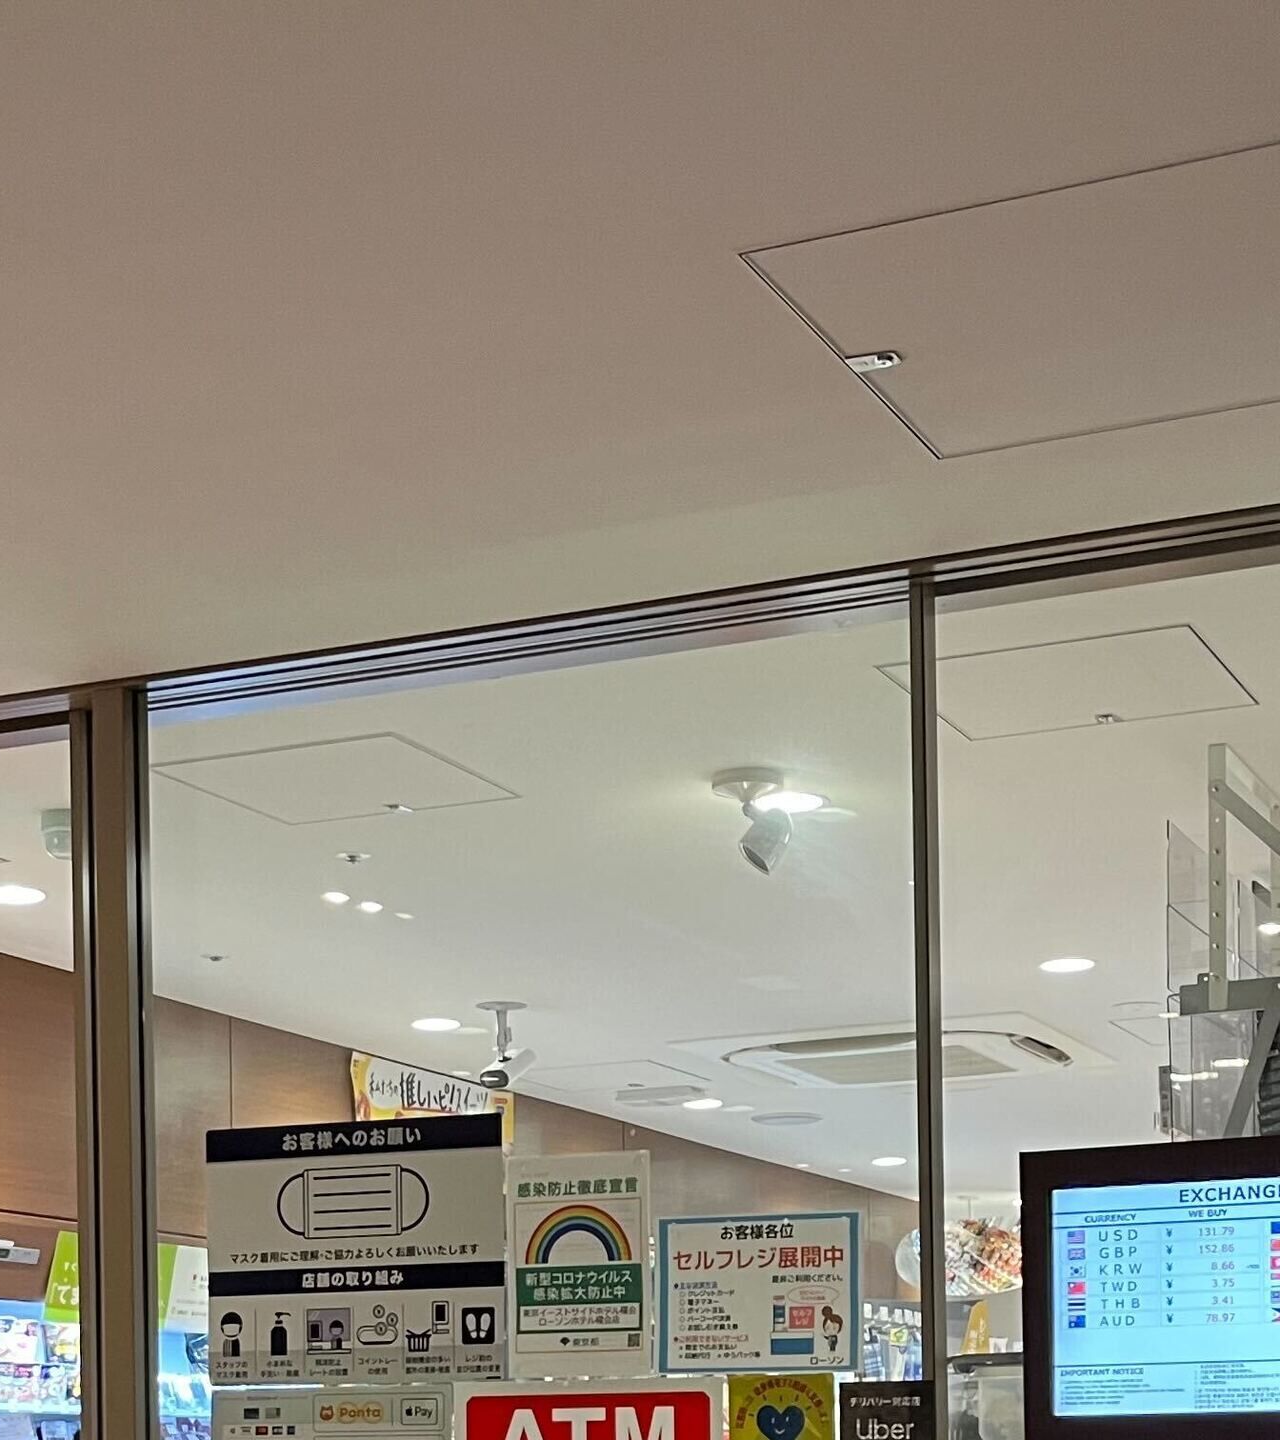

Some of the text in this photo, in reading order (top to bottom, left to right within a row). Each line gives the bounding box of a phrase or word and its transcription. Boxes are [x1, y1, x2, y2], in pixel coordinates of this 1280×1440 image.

[282, 1127, 421, 1150] お客様へのお願い
[517, 1177, 638, 1198] 感染防止徹底宣言
[1085, 1209, 1227, 1224] CURRENCY WE BUY
[720, 1223, 794, 1240] お客様各位
[1099, 1229, 1138, 1241] USD
[673, 1245, 845, 1271] セルフレジ展開中
[1099, 1247, 1137, 1258] GBP
[1099, 1264, 1142, 1275] KRW
[302, 1269, 405, 1288] 店舗の取り組み
[525, 1270, 633, 1287] 新型コロナウイルス
[533, 1286, 626, 1301] 感染拡大防止中
[1101, 1281, 1137, 1292] TWD
[1101, 1298, 1140, 1309] THB
[1100, 1315, 1135, 1327] AUD
[810, 1357, 845, 1365] ローソン
[339, 1406, 433, 1419] Ponta Pay
[856, 1419, 915, 1440] Uber
